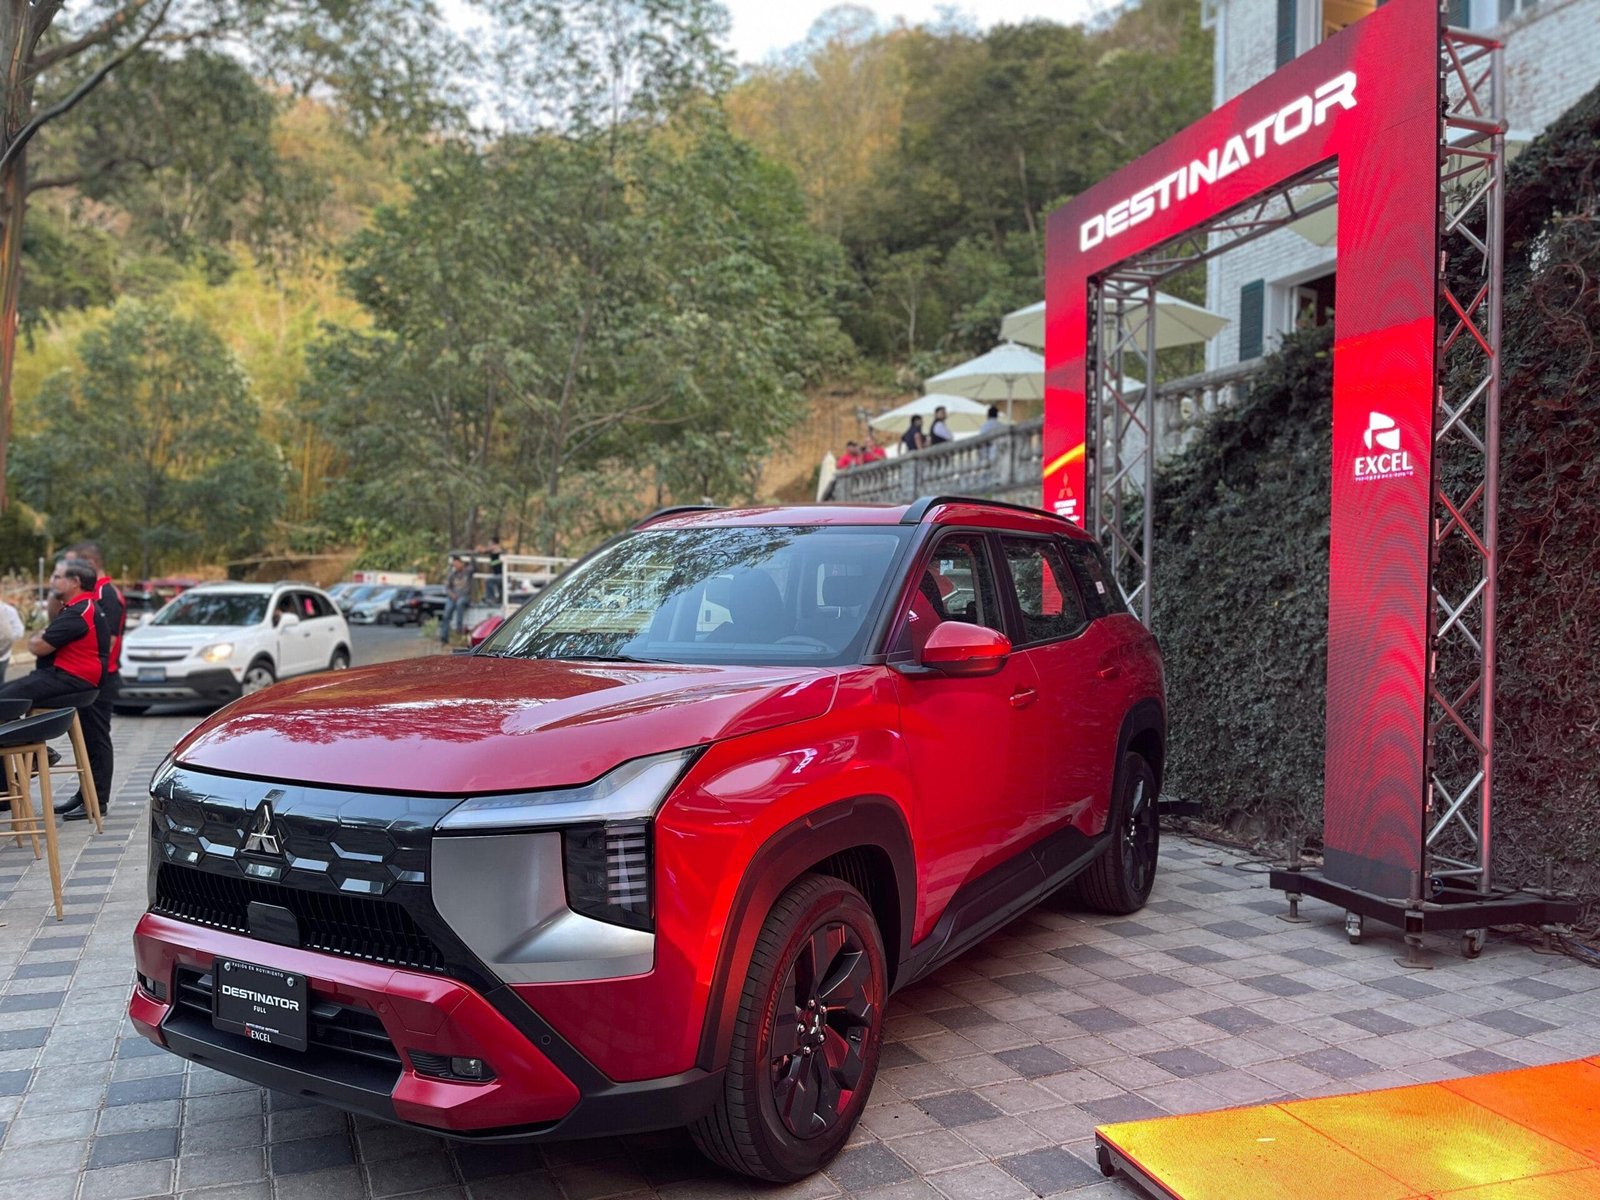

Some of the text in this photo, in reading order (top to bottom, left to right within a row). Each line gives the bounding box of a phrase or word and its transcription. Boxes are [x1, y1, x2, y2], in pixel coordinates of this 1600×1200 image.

[1080, 71, 1357, 252] DESTINATOR
[1355, 451, 1413, 476] EXCEL
[222, 984, 299, 1012] DESTINATOR
[253, 1005, 267, 1014] FULL
[251, 1030, 272, 1043] EXCEL
